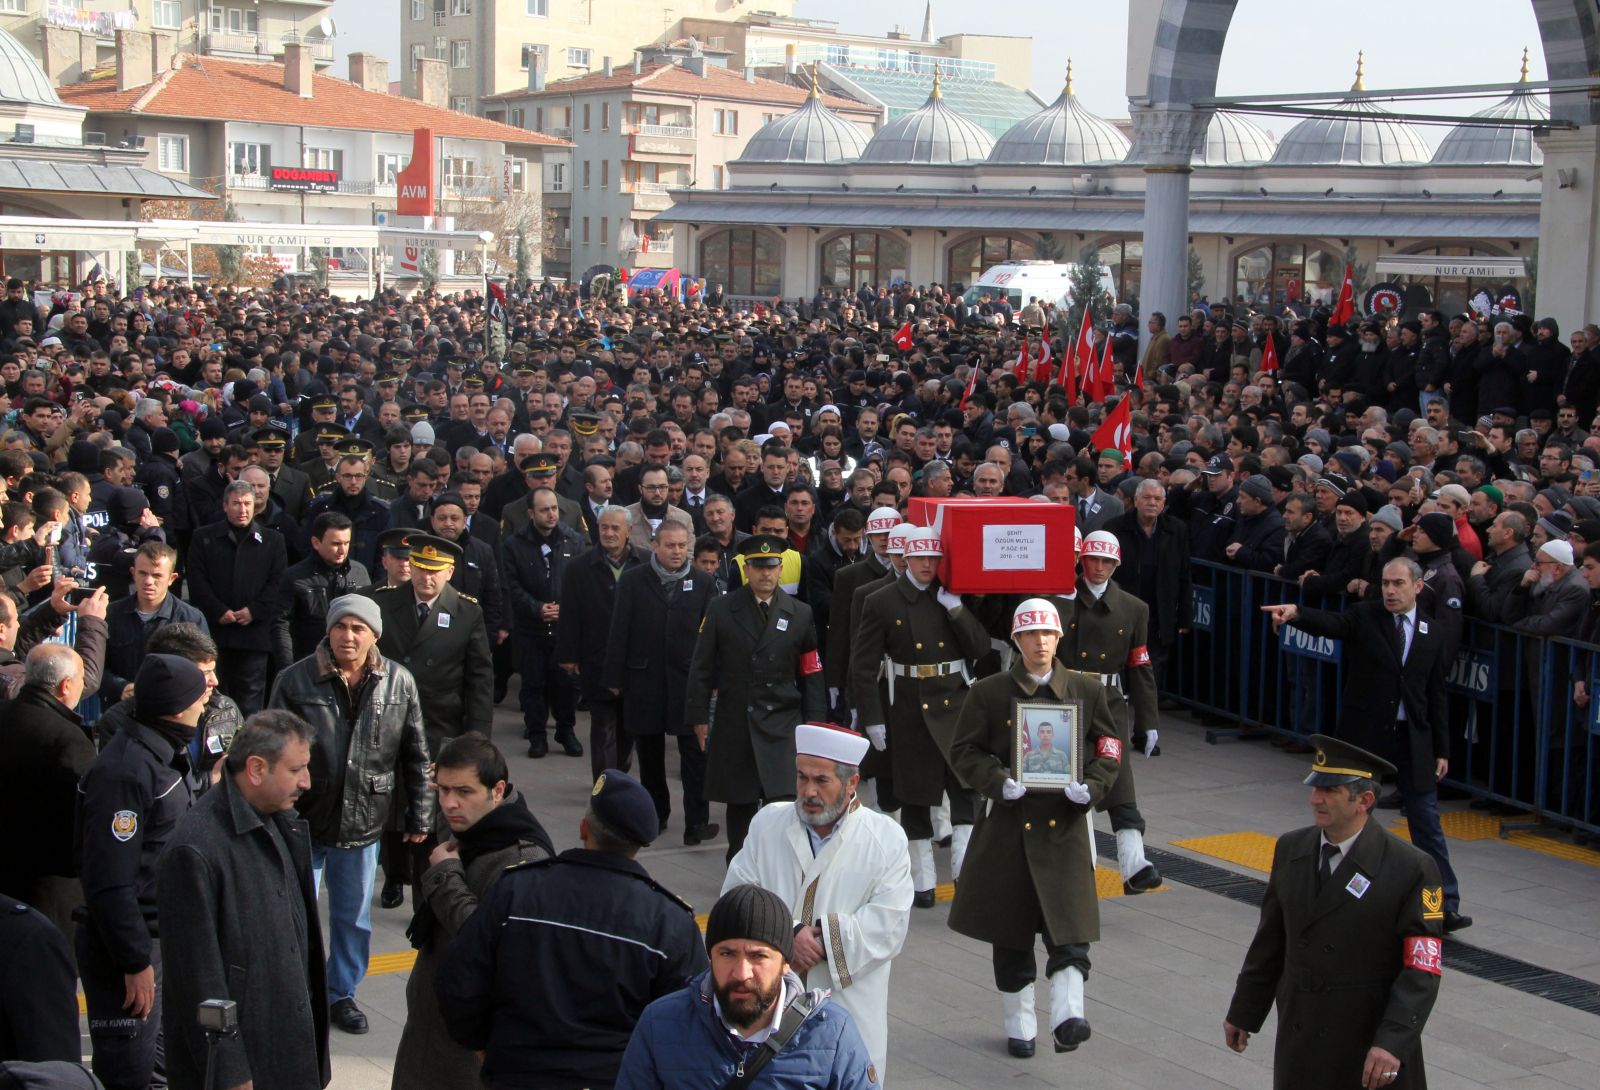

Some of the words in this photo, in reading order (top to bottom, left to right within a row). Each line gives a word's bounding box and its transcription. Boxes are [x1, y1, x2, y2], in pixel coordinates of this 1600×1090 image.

[272, 168, 337, 182] DOĞANBEY
[401, 185, 427, 199] AVM
[237, 235, 264, 244] NUR
[1435, 266, 1458, 275] NUR
[992, 272, 1011, 285] 112
[109, 1018, 137, 1028] KUVVET
